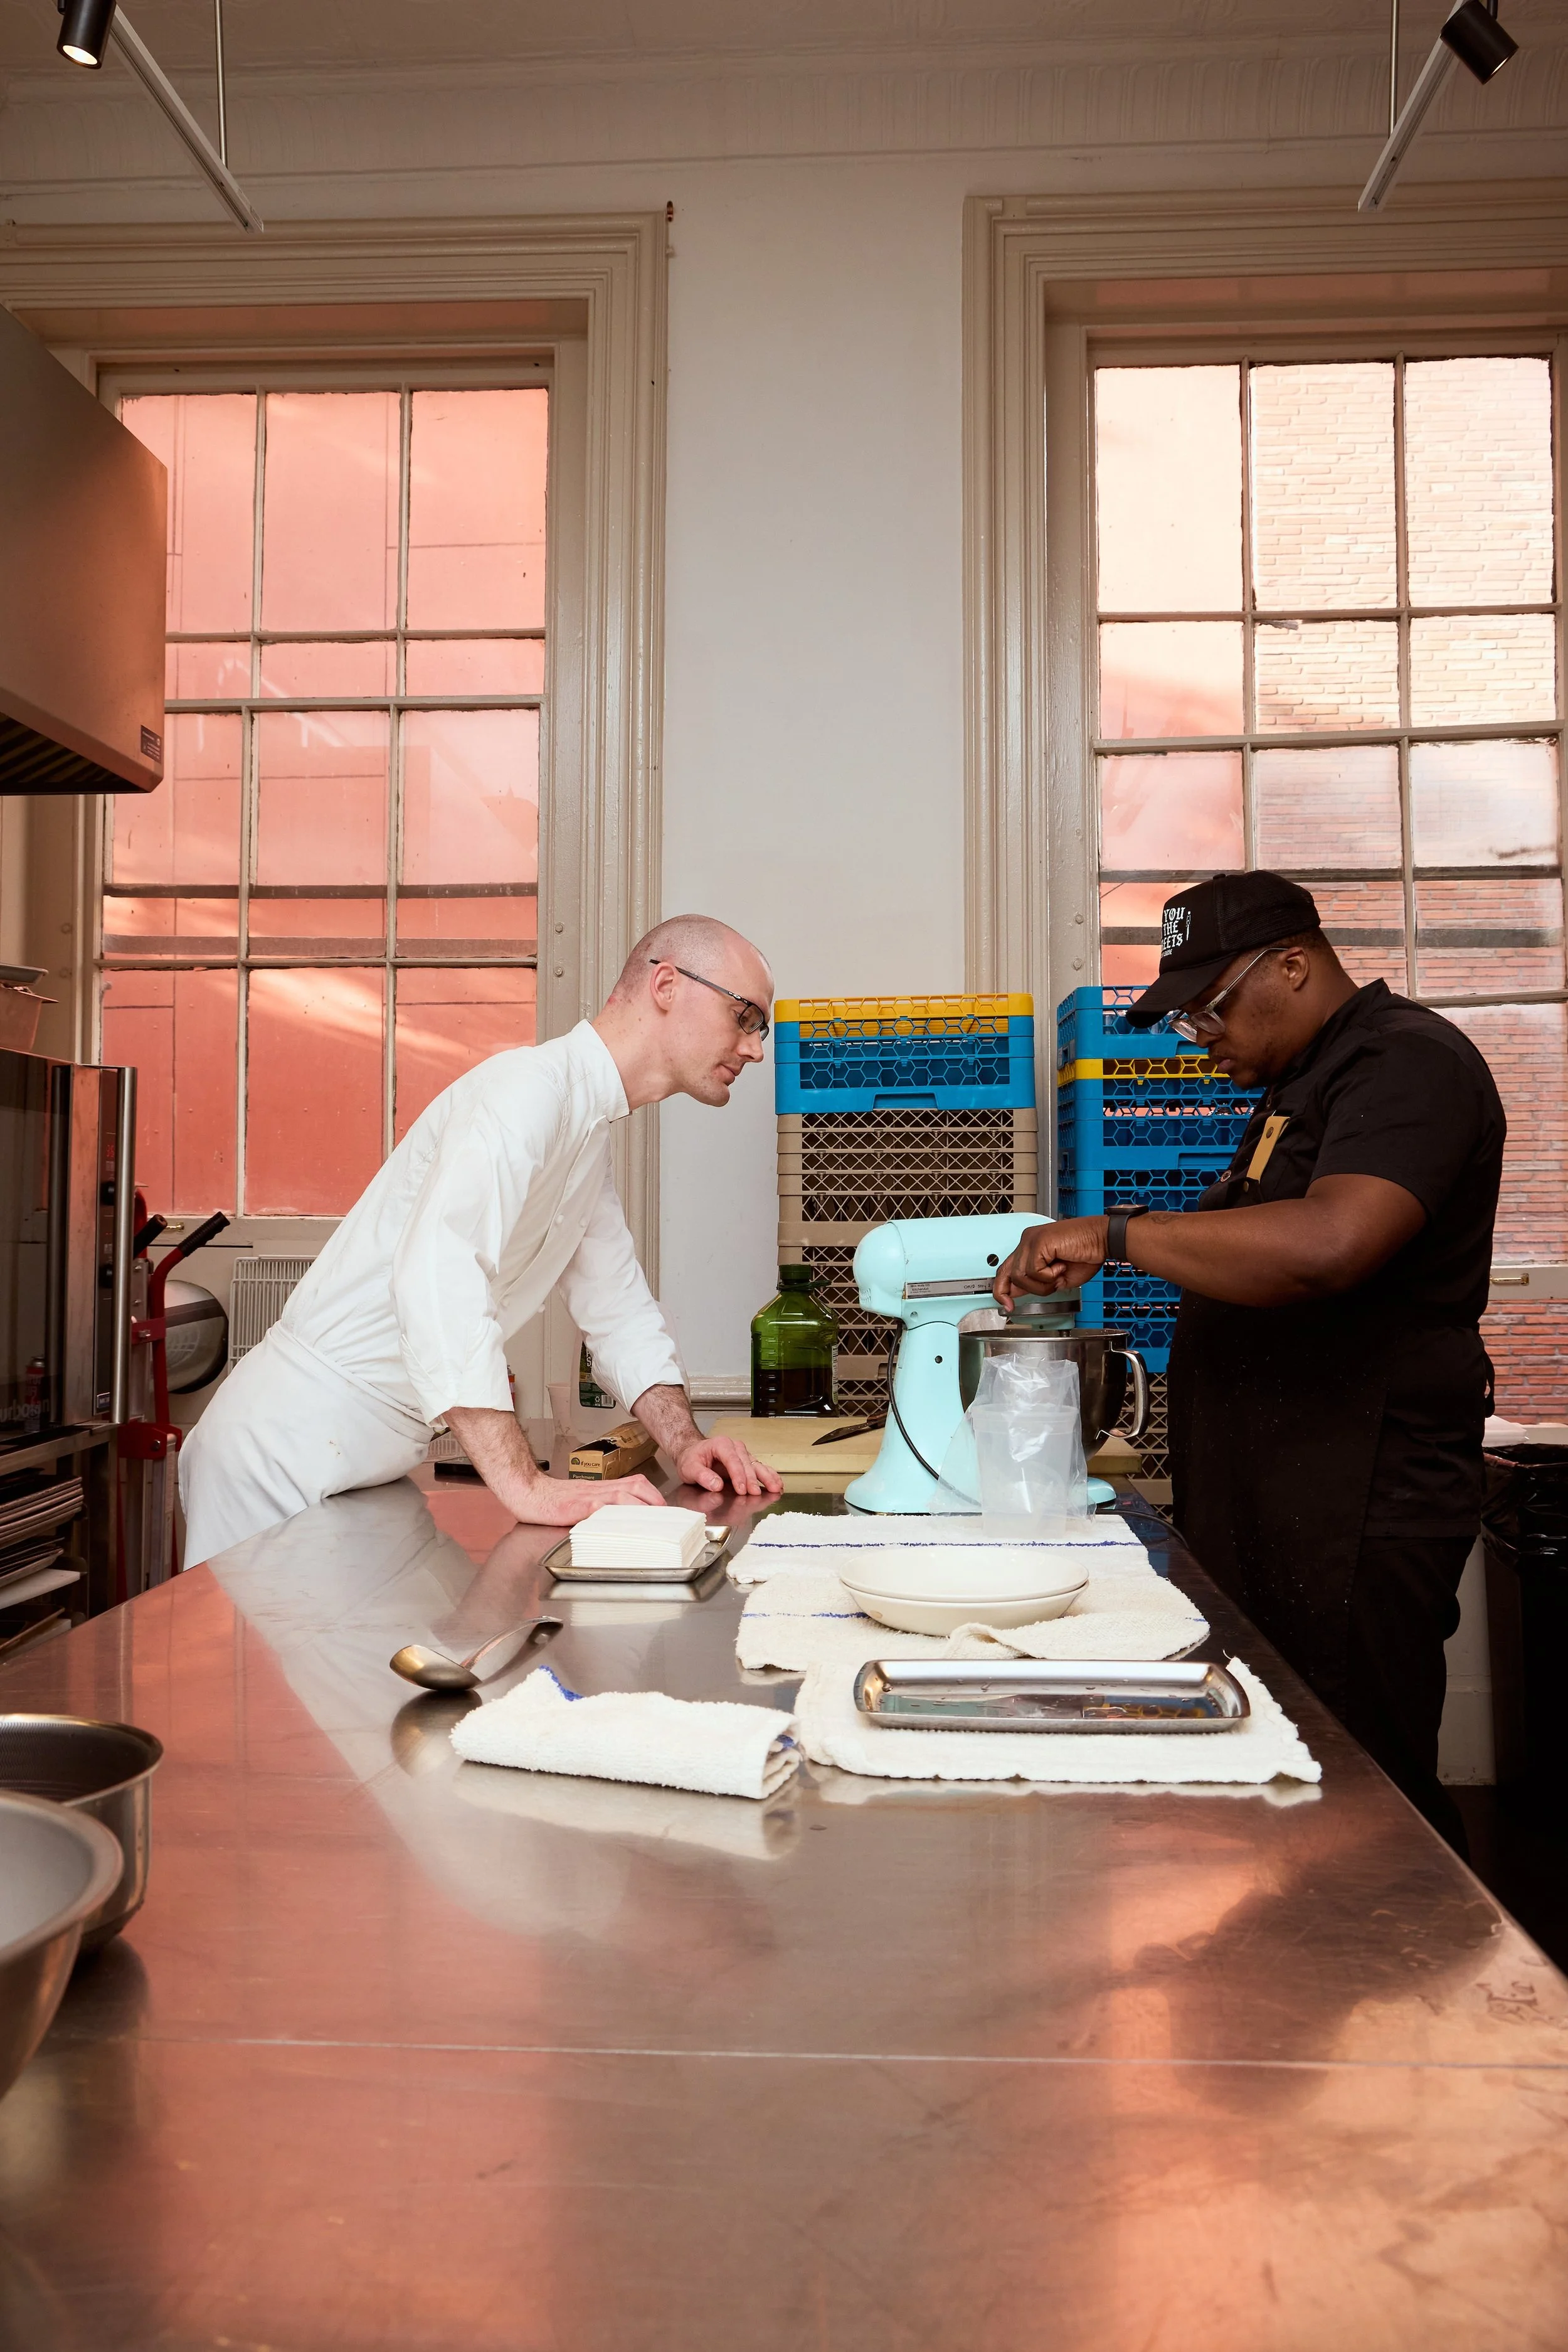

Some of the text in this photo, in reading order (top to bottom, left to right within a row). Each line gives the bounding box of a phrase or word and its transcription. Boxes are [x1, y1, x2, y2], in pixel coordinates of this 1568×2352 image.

[1164, 907, 1185, 922] YOU
[1163, 920, 1179, 936] THE
[1162, 933, 1183, 950] EETS
